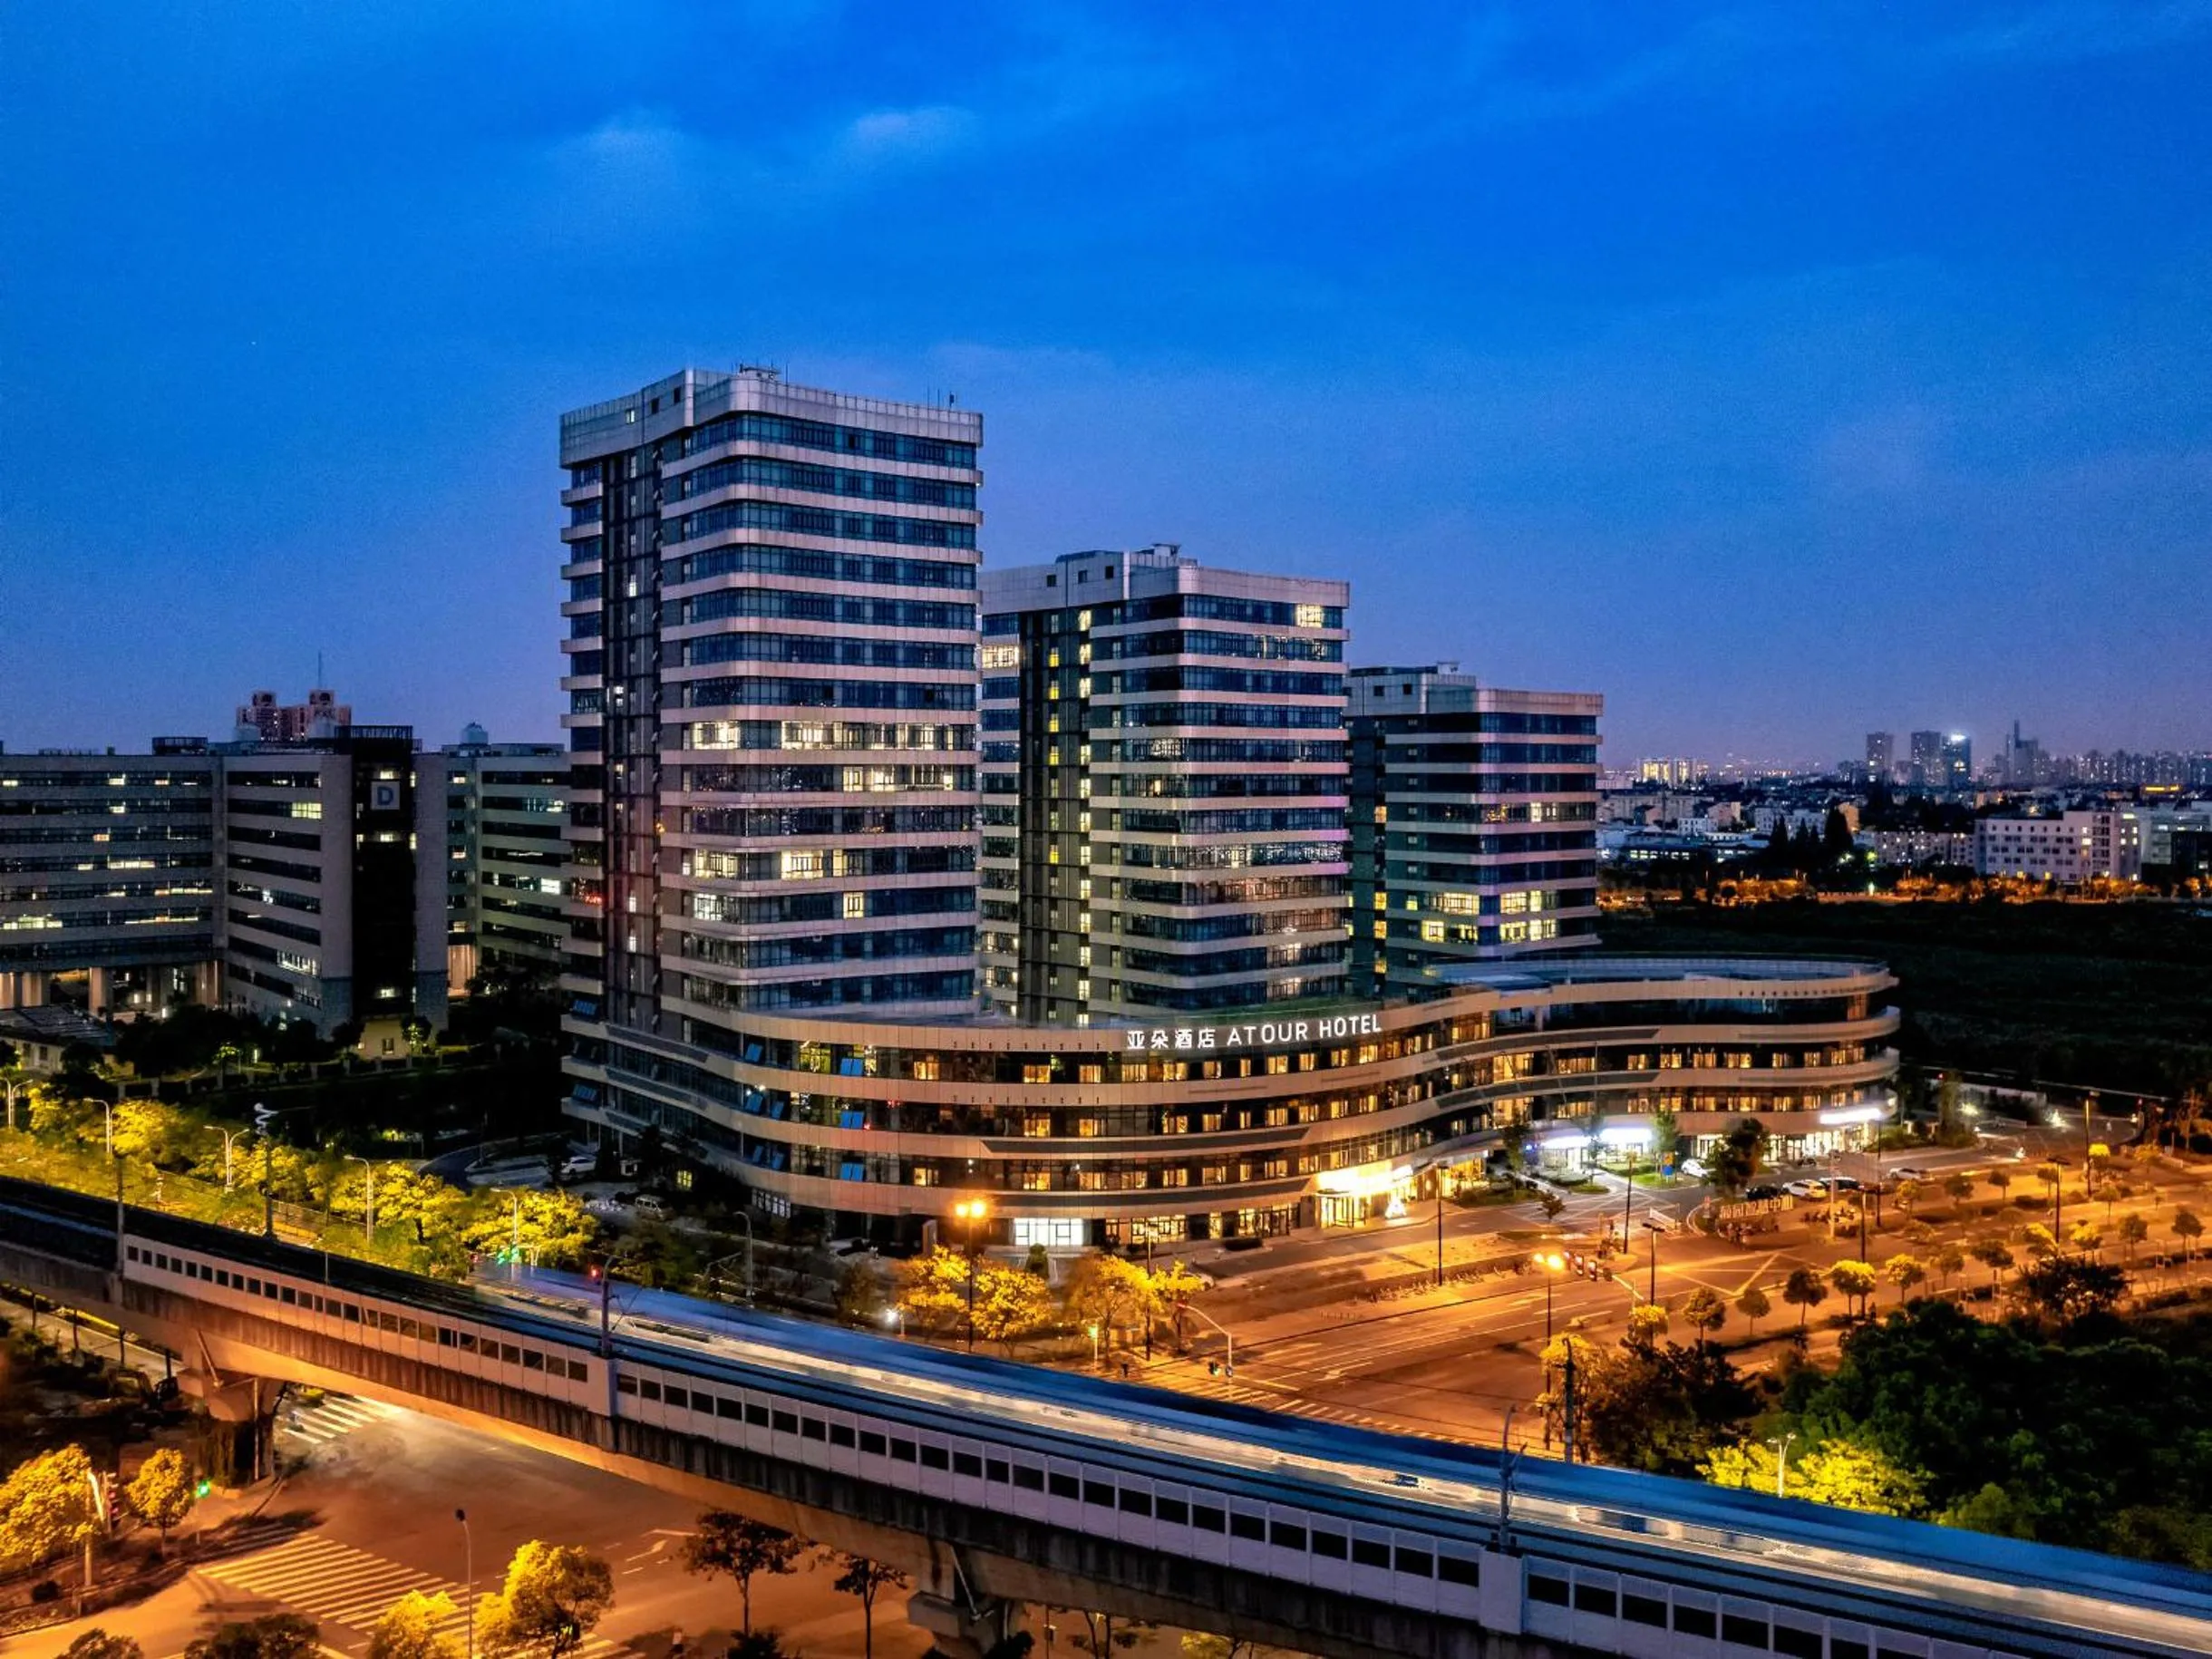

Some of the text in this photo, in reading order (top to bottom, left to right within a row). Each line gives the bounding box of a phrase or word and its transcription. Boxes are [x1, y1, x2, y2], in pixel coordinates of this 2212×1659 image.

[1127, 1014, 1382, 1050] 亚朵酒店 ATOUR HOTEL
